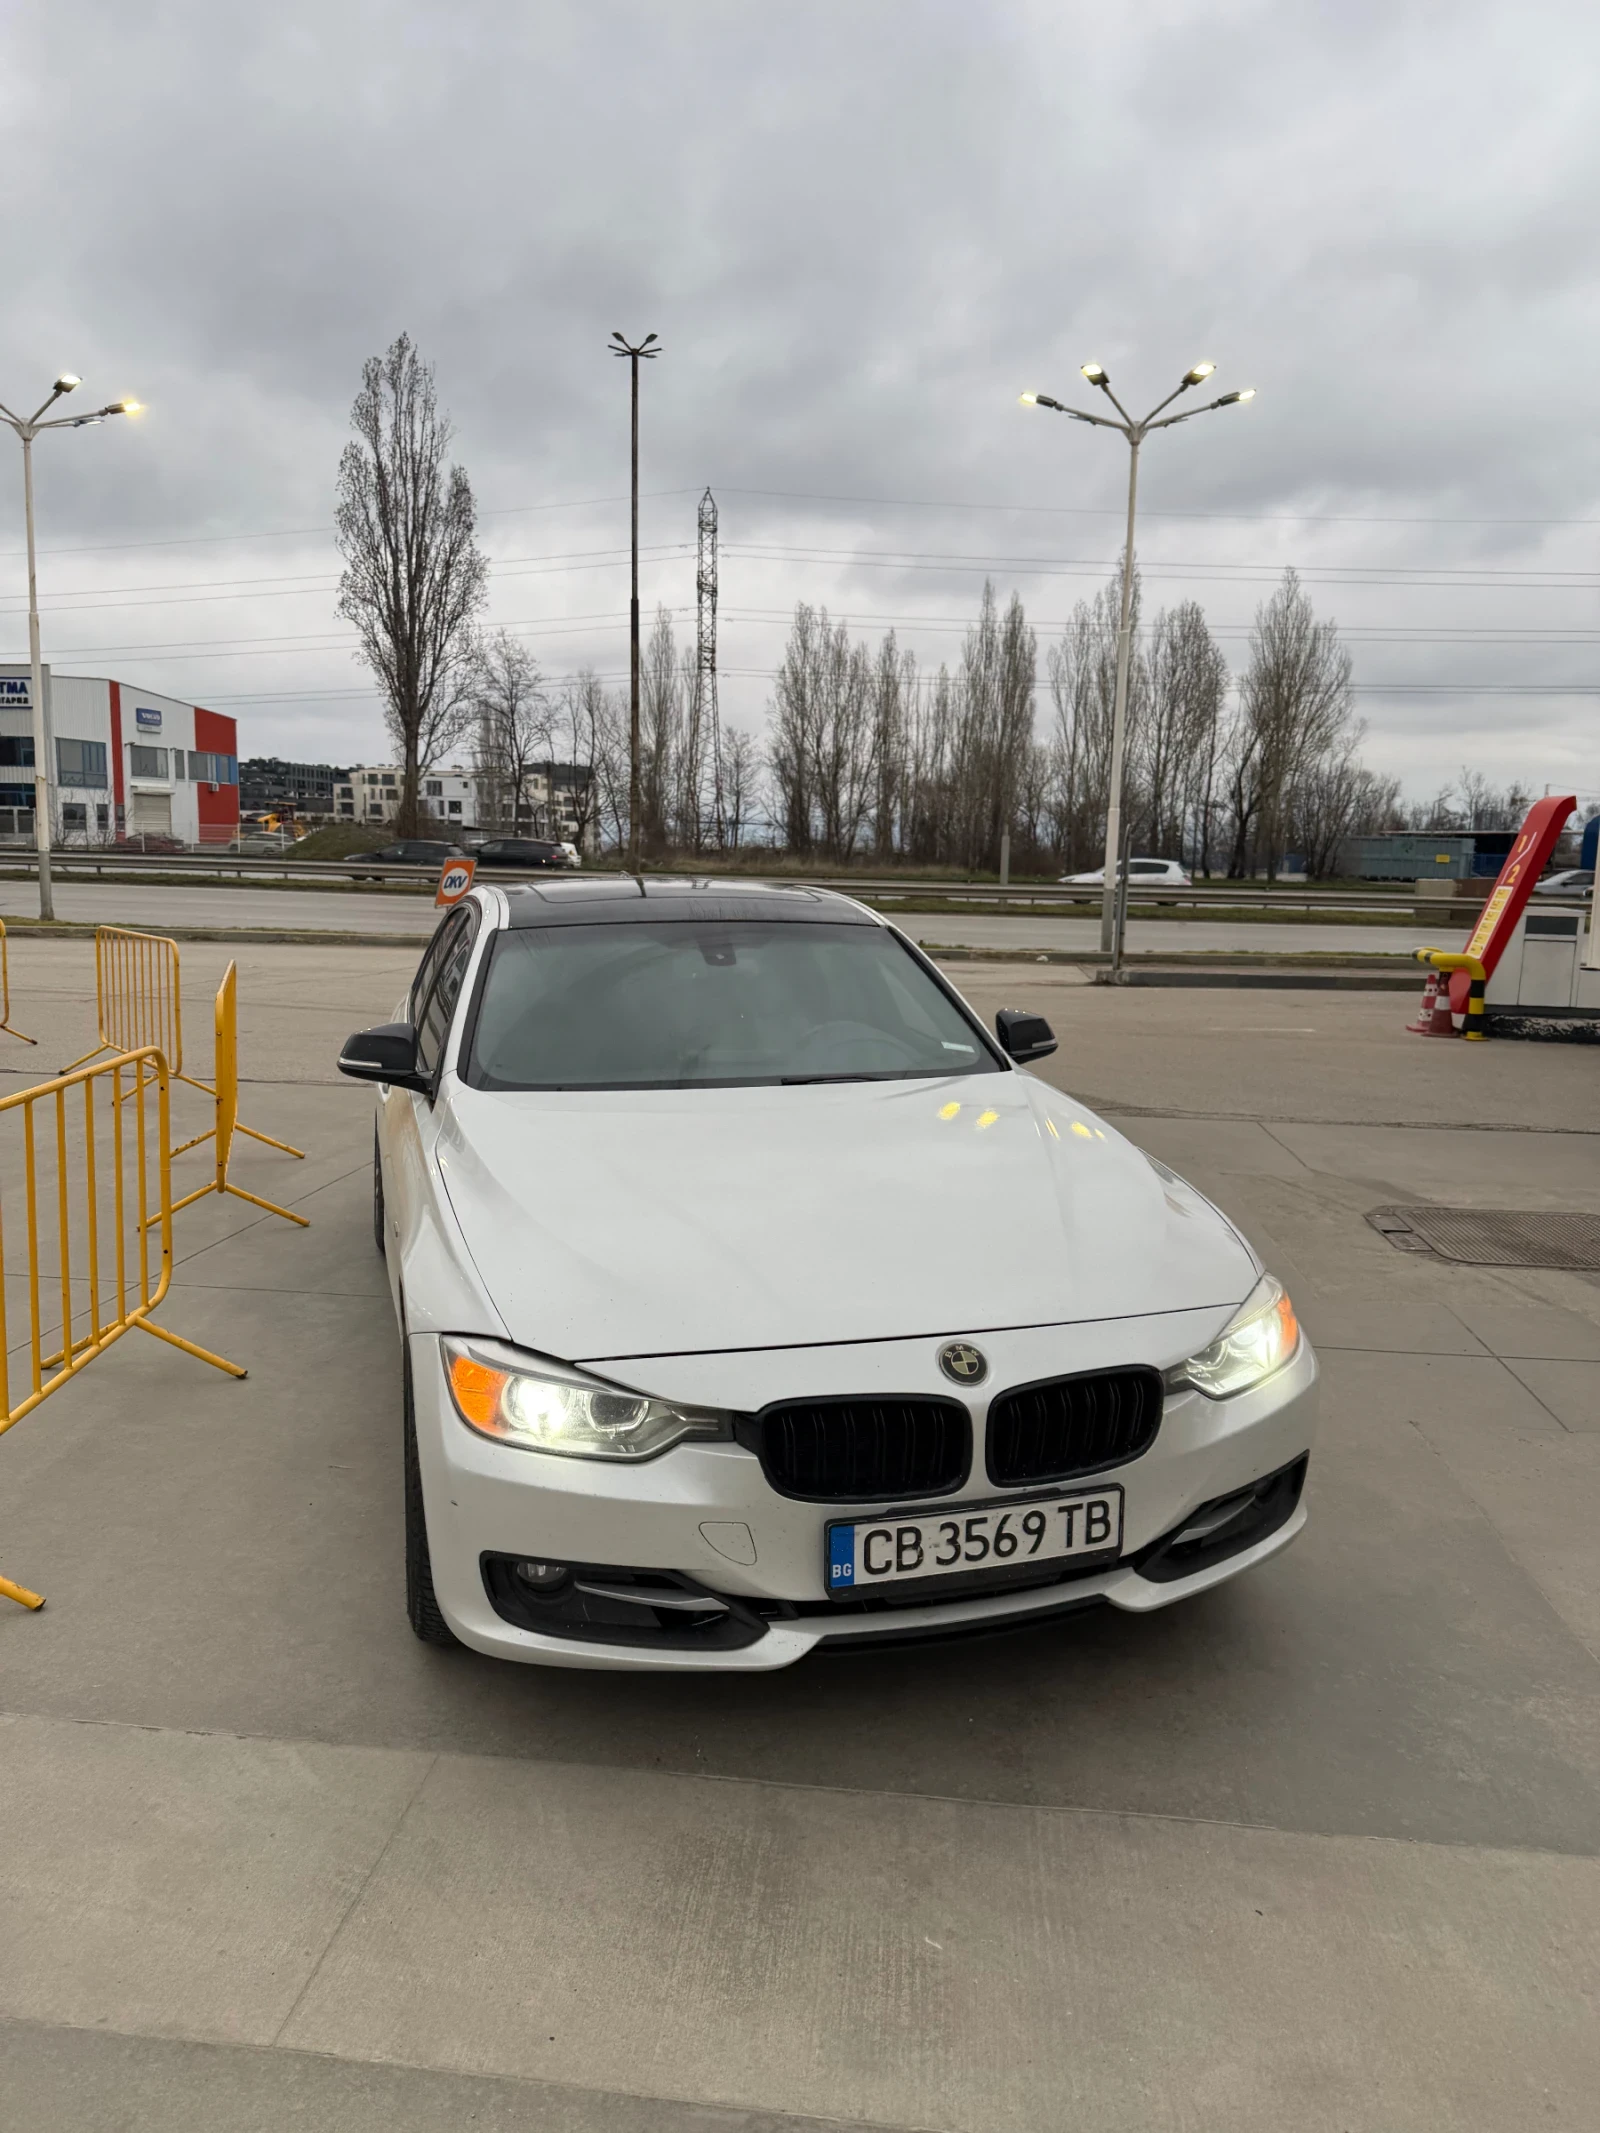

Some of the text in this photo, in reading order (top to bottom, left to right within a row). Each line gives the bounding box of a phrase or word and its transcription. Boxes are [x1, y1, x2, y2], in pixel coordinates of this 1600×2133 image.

[443, 875, 468, 889] DKV
[1506, 864, 1521, 884] 2
[944, 1345, 979, 1359] BMW
[863, 1500, 1112, 1576] CB 3569 TB
[832, 1563, 853, 1579] BG
